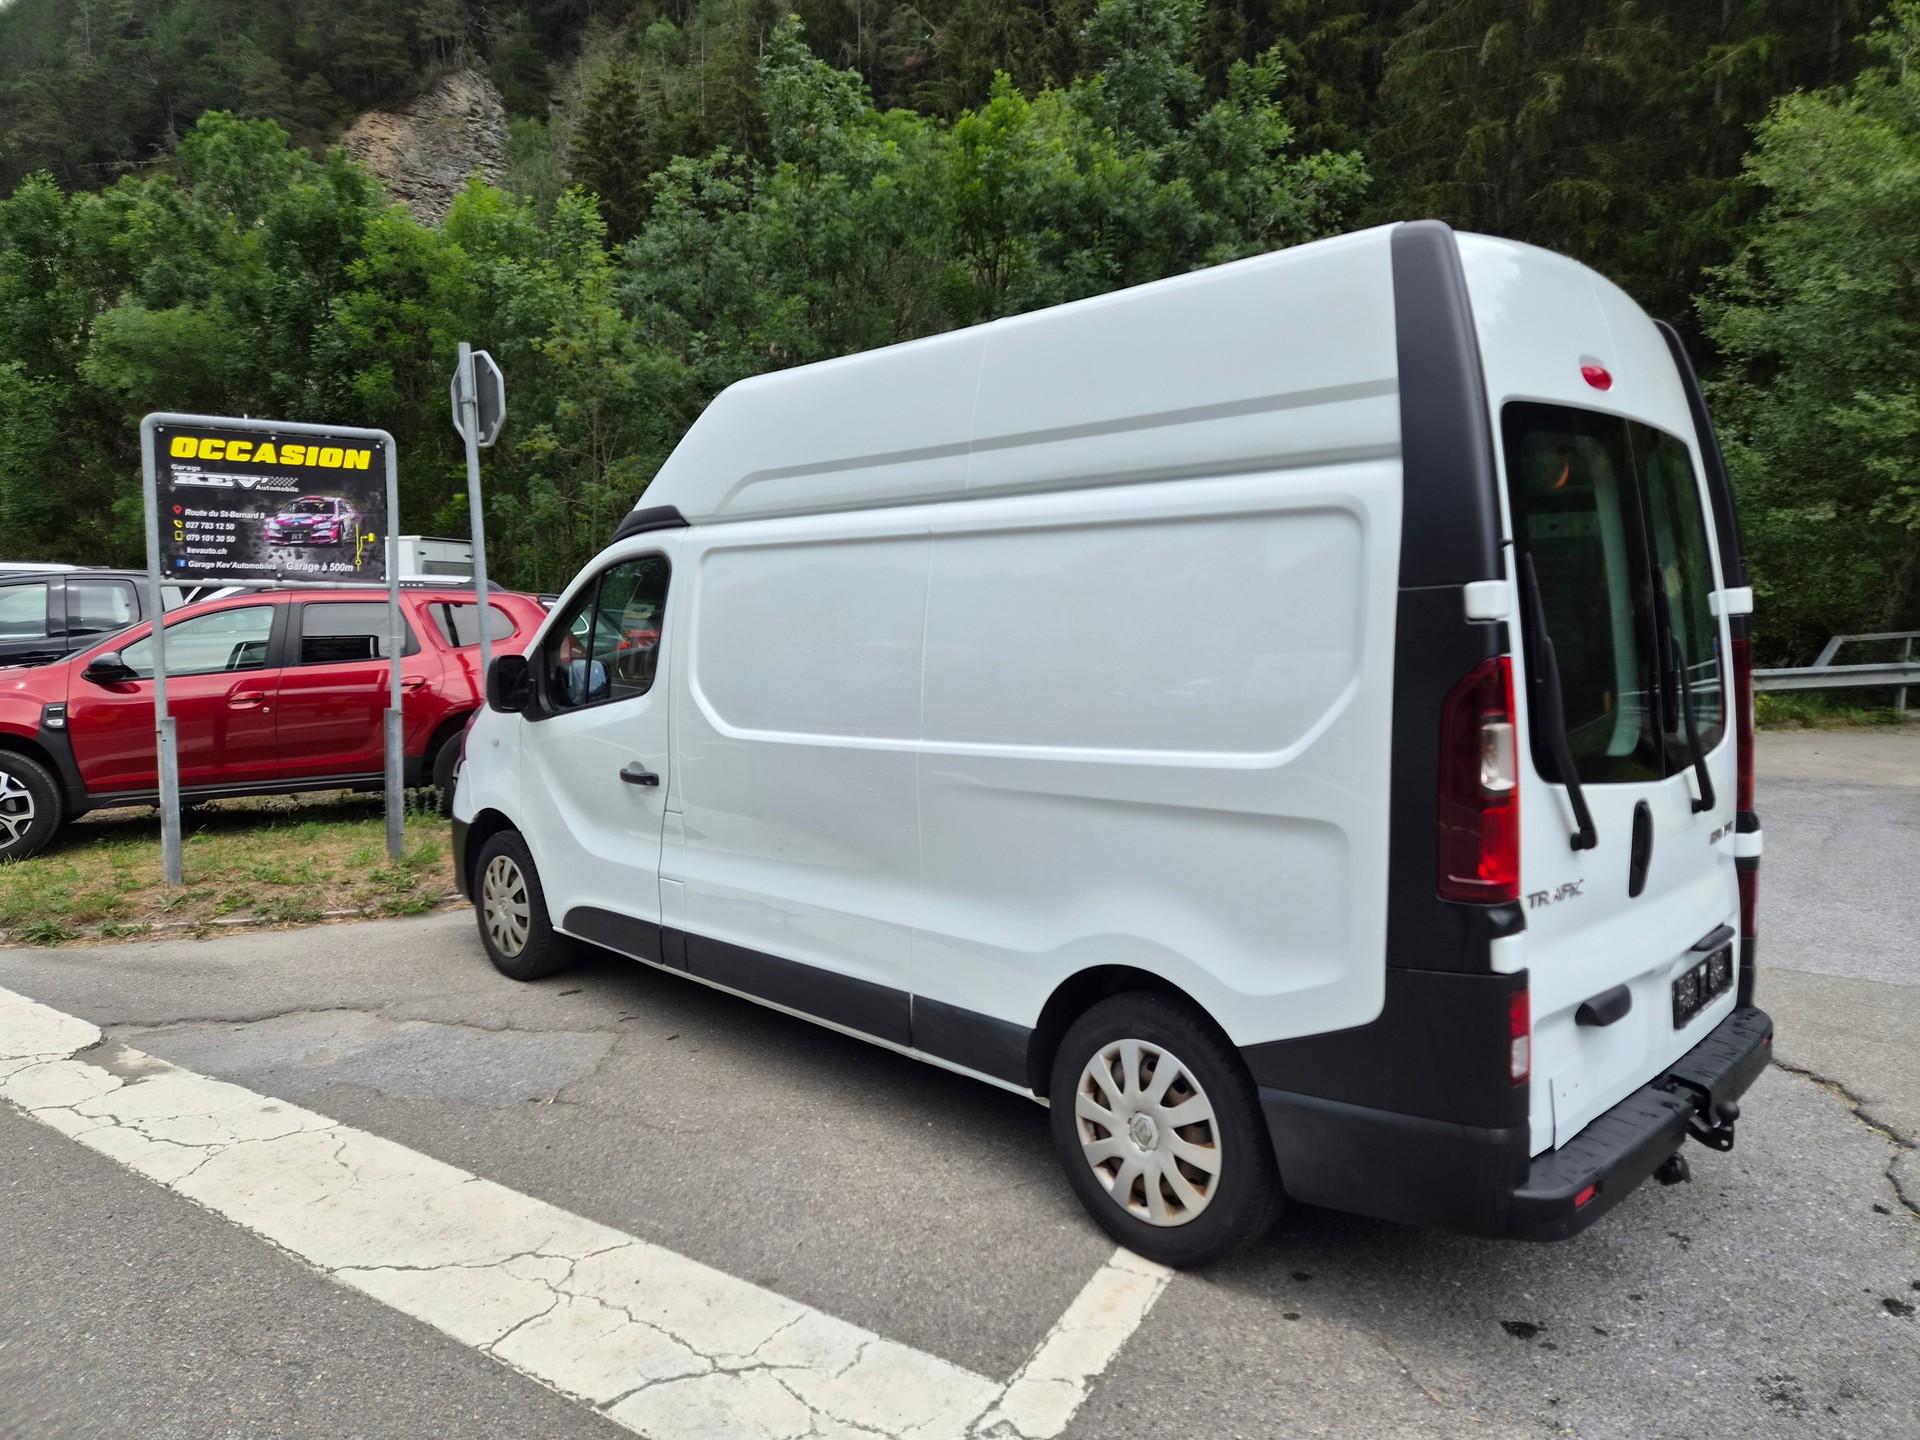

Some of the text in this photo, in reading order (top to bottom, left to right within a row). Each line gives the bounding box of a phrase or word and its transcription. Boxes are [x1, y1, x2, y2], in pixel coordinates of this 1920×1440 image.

[170, 437, 371, 470] OCCASION
[170, 463, 202, 472] Garage
[255, 484, 300, 493] Automobile
[184, 508, 208, 517] Route
[220, 511, 260, 519] St-Bernard
[185, 521, 200, 529] 027
[200, 522, 214, 530] 783
[216, 522, 225, 530] 12
[185, 534, 200, 542] 079
[226, 535, 236, 543] 50
[186, 546, 228, 555] kevauto.ch
[188, 560, 215, 570] Garage
[216, 561, 277, 570] Kev'Automobiles
[286, 562, 354, 572] Garage à 500m
